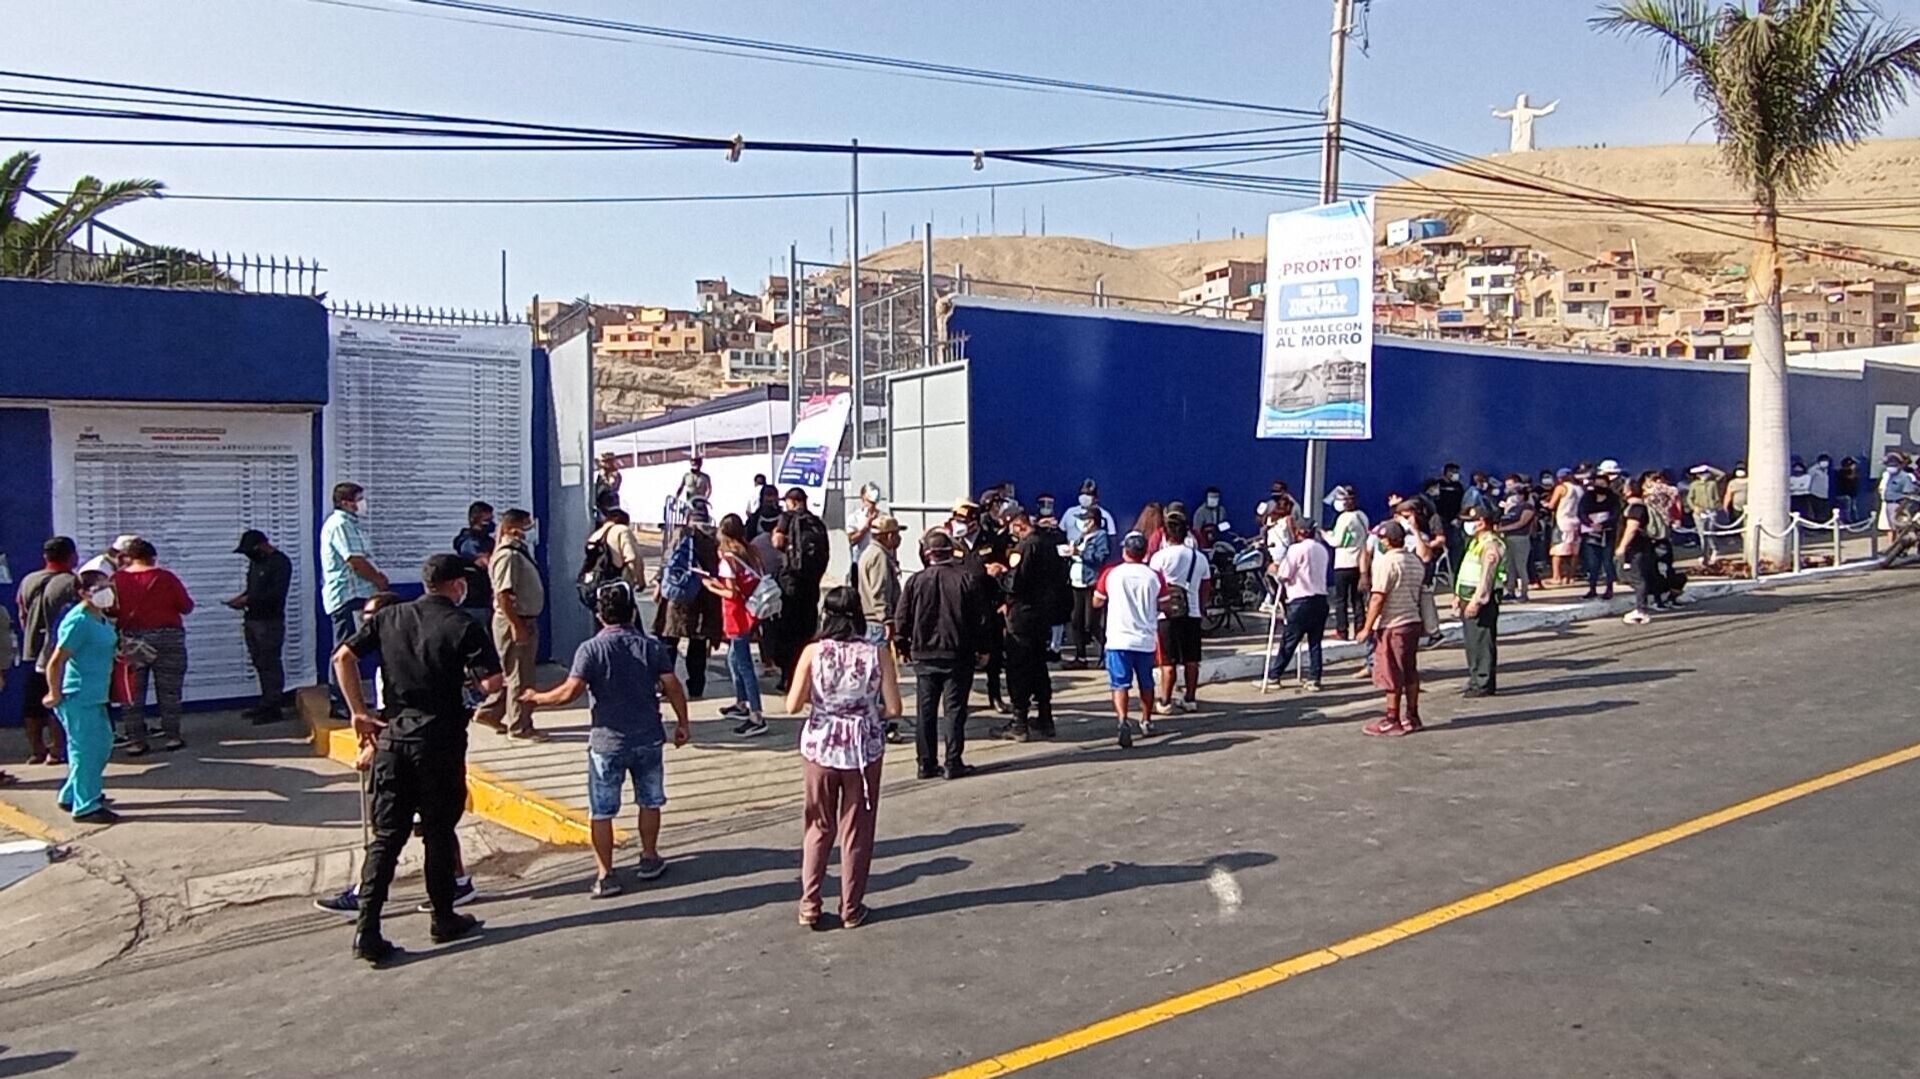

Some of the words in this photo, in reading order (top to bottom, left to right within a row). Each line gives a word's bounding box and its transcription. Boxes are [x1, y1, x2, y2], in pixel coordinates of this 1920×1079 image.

[1276, 326, 1298, 338] DEL
[1276, 335, 1296, 348] AL
[1301, 331, 1363, 347] MORRO
